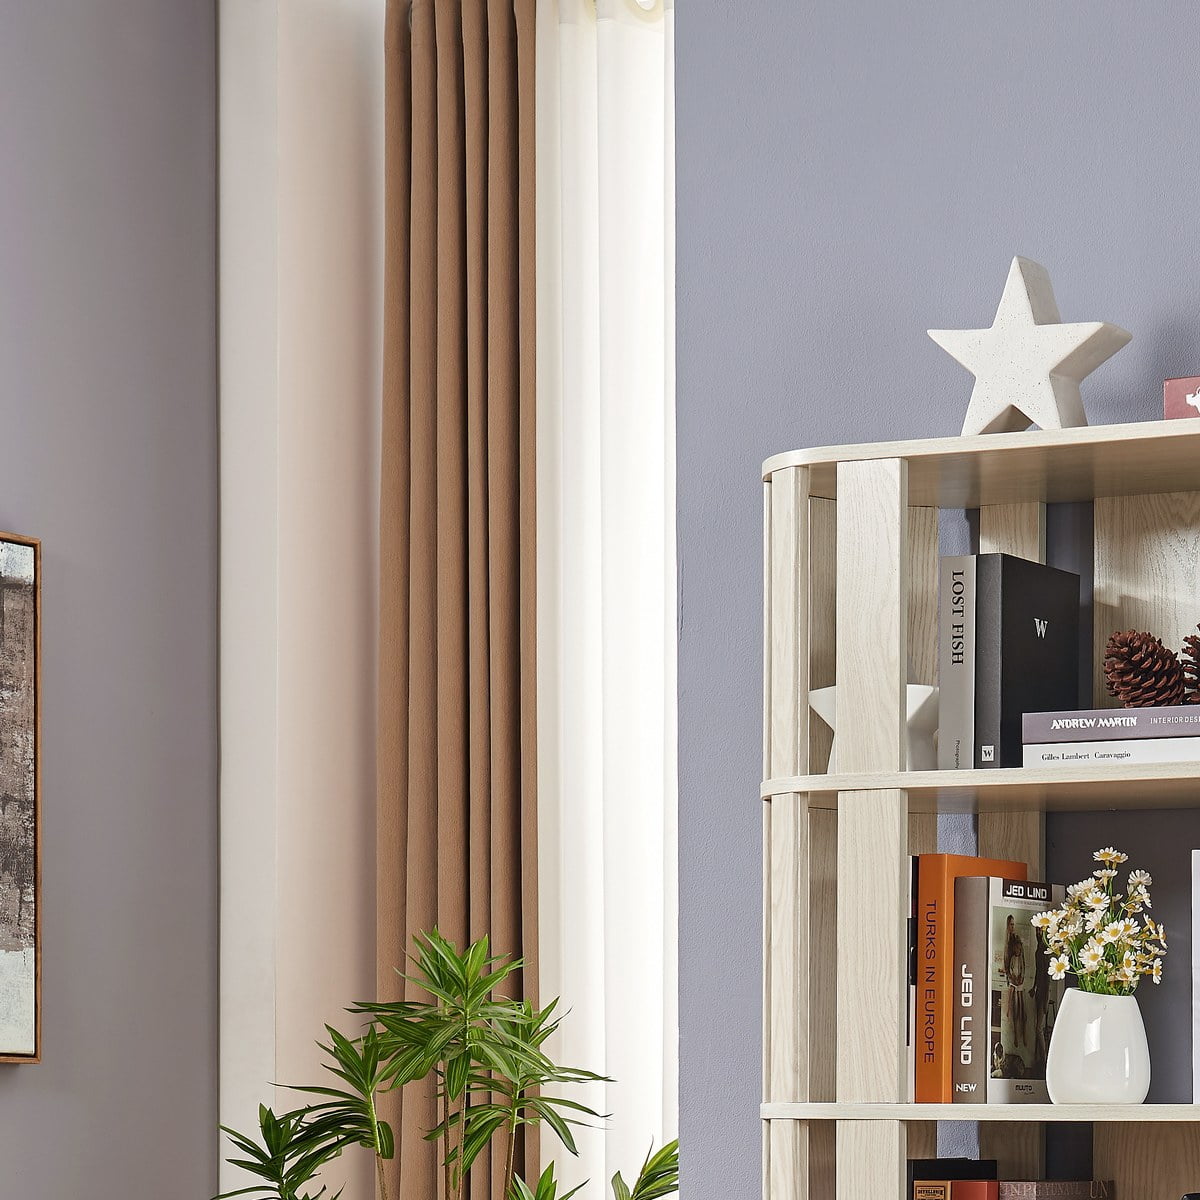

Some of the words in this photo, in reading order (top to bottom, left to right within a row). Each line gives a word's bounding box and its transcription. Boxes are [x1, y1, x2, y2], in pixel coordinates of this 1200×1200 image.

[951, 570, 965, 618] LOST
[1033, 617, 1049, 640] W
[951, 624, 964, 665] FISH
[1051, 718, 1096, 730] ANDREW
[1096, 716, 1138, 728] MARTIN
[1150, 715, 1183, 725] INTERIOR
[1061, 751, 1090, 760] Lambert
[1094, 750, 1131, 761] Caravaggio
[1005, 884, 1024, 897] JED
[1027, 885, 1048, 900] LIND
[925, 900, 937, 960] TURKS
[924, 966, 935, 983] IN
[961, 963, 973, 1007] JED
[923, 988, 936, 1064] EUROPE
[960, 1016, 973, 1065] LIND
[955, 1083, 977, 1093] NEW
